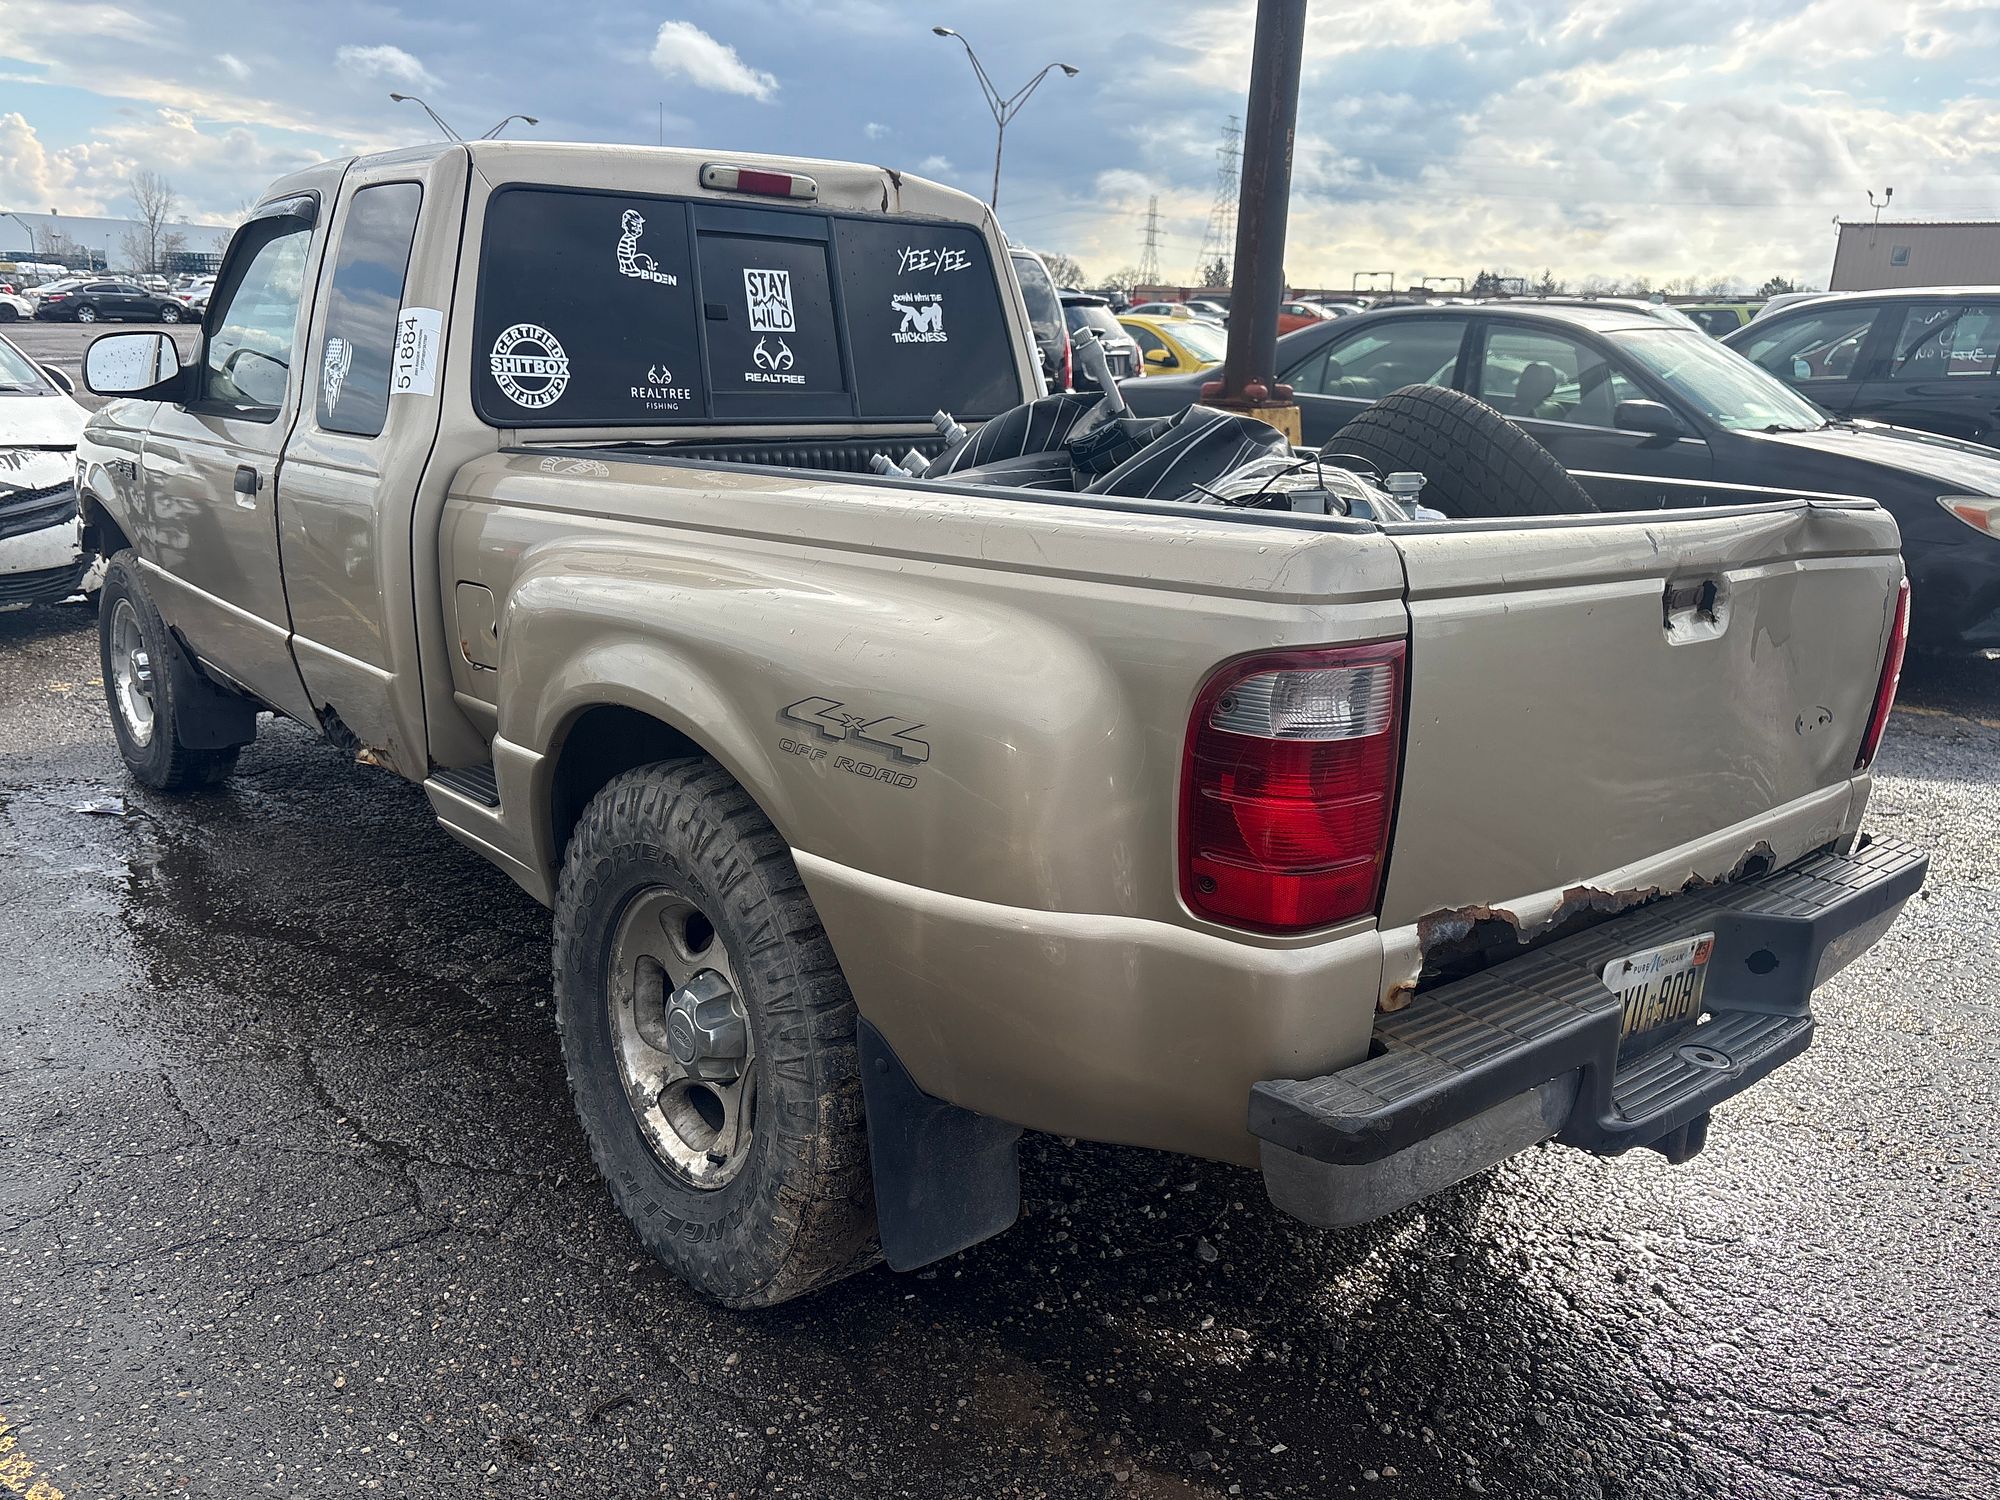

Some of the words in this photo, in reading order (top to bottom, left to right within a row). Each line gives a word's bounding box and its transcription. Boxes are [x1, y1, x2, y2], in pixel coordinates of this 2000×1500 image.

[897, 246, 936, 276] YEE
[933, 247, 972, 276] YEE
[640, 269, 678, 287] BIDEN
[747, 271, 788, 300] STAY
[893, 292, 914, 302] DOWN
[914, 292, 930, 302] WITH
[930, 293, 943, 302] THE
[751, 308, 793, 329] WILD
[497, 327, 562, 358] CERTIFIED
[891, 331, 948, 343] THICKNESS
[397, 316, 417, 388] 51884
[490, 358, 570, 375] SHITBOX
[744, 372, 806, 384] REALTREE
[499, 375, 563, 406] CERTIFIED
[630, 387, 691, 400] REALTREE
[646, 402, 679, 410] FISHING
[778, 738, 827, 761] OFF
[834, 756, 918, 789] ROAD
[1633, 963, 1650, 979] PURE
[1613, 982, 1649, 1035] YU
[1653, 967, 1696, 1026] 908
